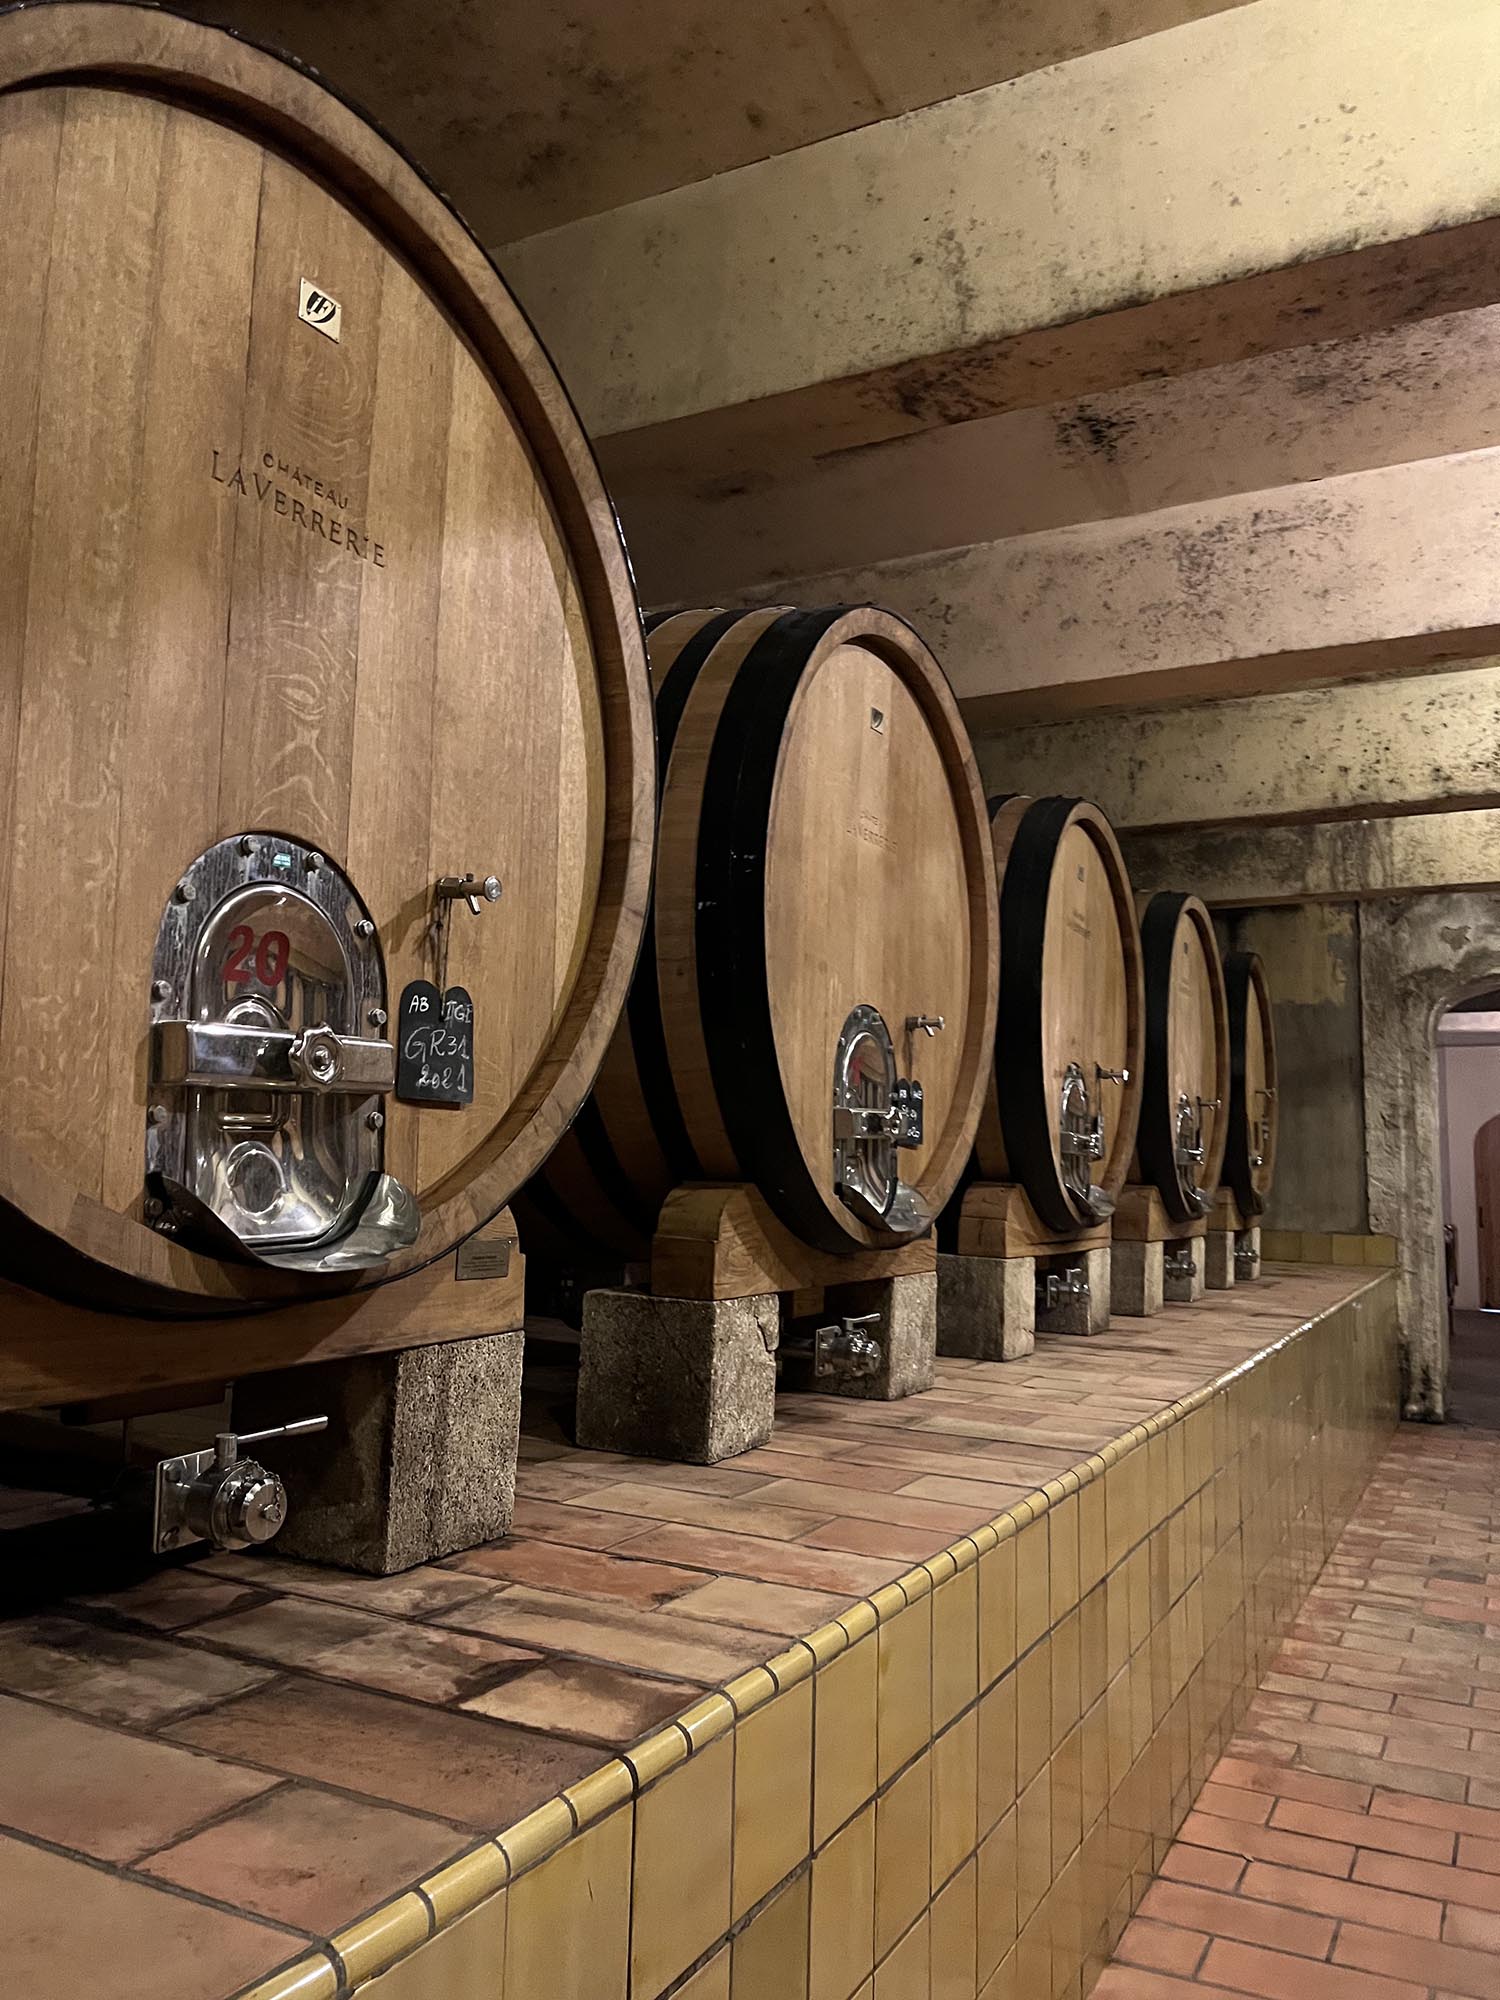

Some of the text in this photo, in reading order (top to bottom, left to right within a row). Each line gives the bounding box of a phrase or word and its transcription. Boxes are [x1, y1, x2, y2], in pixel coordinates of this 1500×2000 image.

[222, 924, 290, 986] 20
[408, 994, 430, 1014] AB
[415, 1063, 468, 1093] 2021
